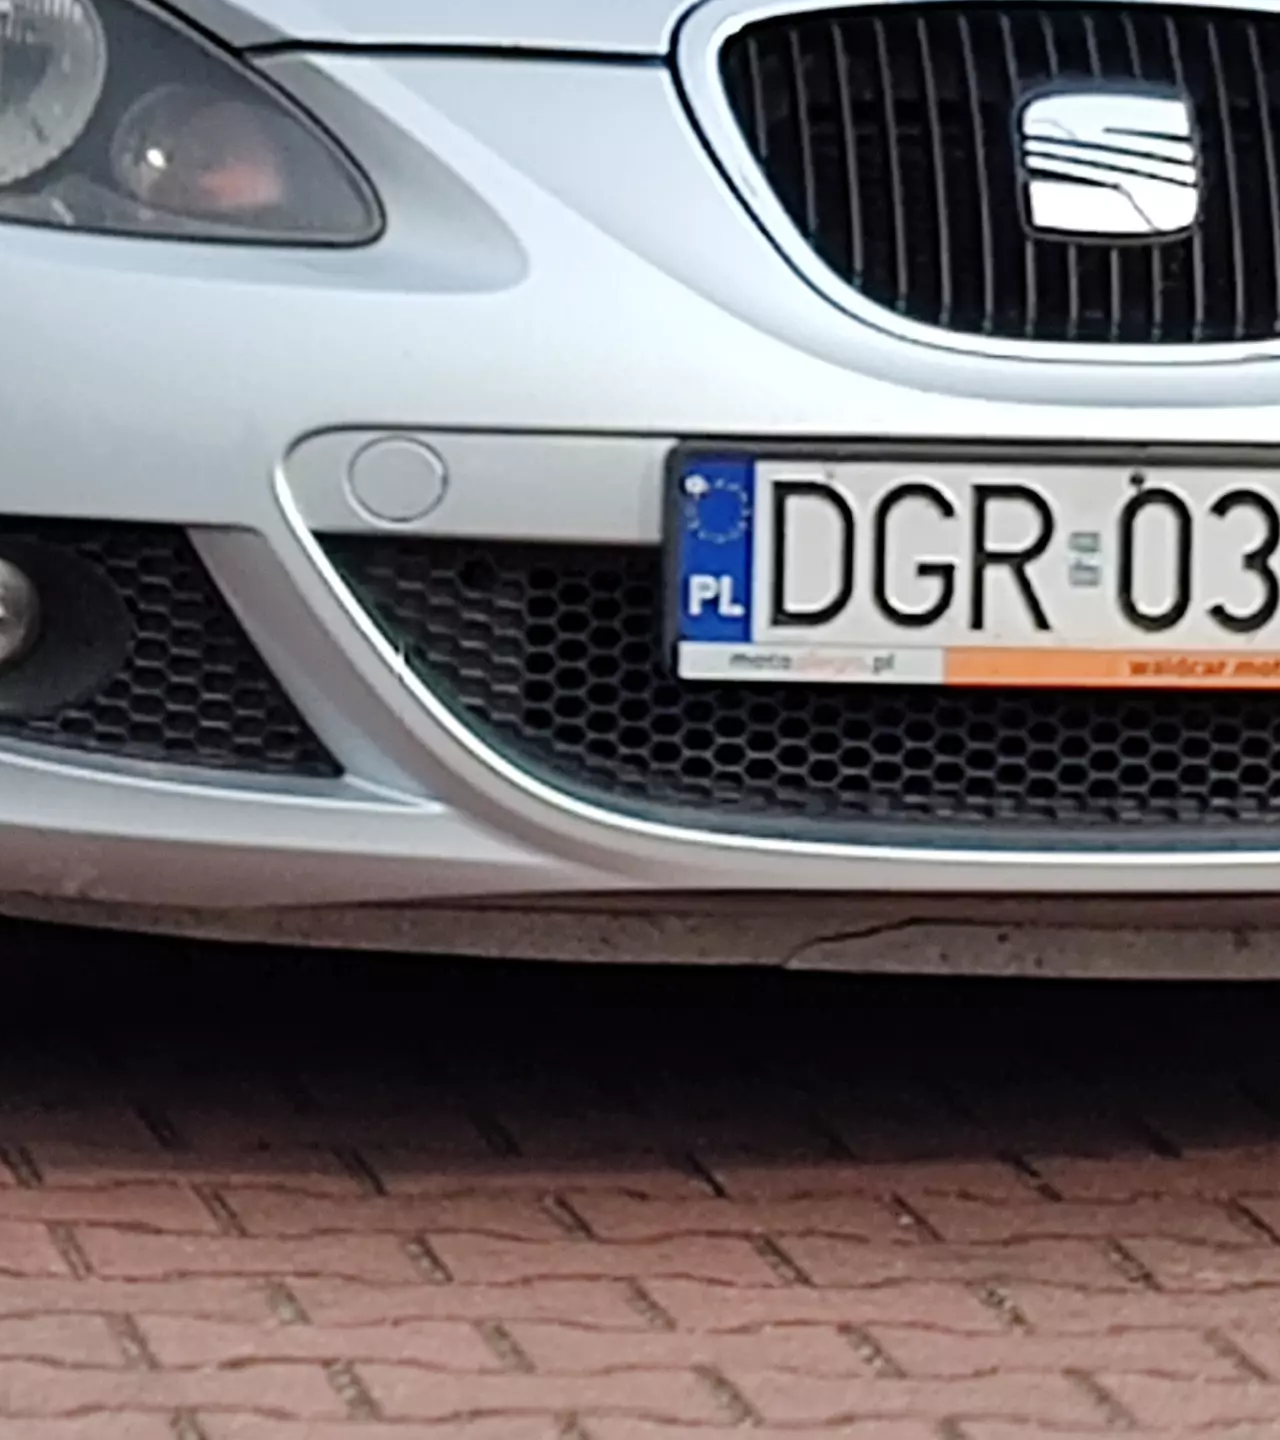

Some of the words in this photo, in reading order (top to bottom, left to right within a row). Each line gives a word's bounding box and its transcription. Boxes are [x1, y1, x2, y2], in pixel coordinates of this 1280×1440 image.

[767, 478, 1052, 631] DGR
[687, 573, 746, 617] PL
[728, 652, 895, 676] moto.pl
